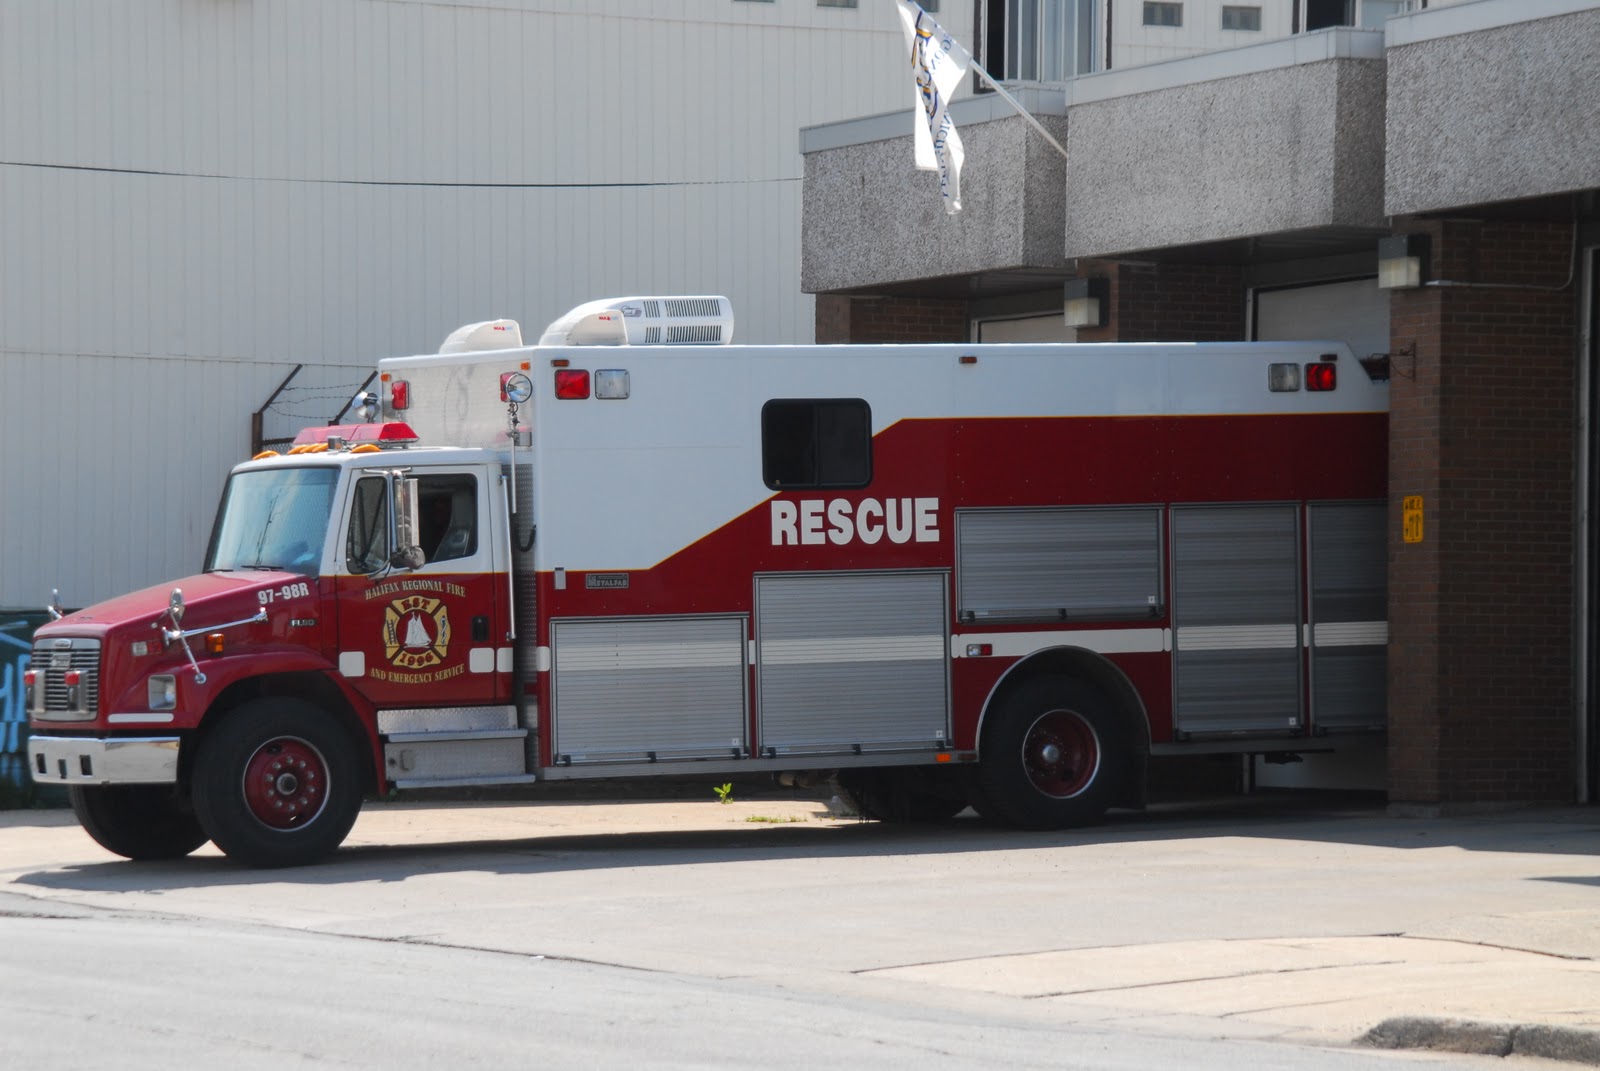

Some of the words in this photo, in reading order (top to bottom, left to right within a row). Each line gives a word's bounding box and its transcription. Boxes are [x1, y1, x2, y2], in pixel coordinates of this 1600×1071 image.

[771, 498, 940, 546] RESCUE
[258, 582, 309, 605] 97-98R
[365, 582, 399, 600] HALIFAX
[402, 580, 443, 592] REGIONAL
[447, 583, 466, 597] FIRE
[401, 597, 431, 610] EST
[399, 653, 434, 666] 1996
[370, 668, 386, 680] AND
[388, 672, 433, 683] EMERGENCY
[434, 664, 465, 681] SERVICE
